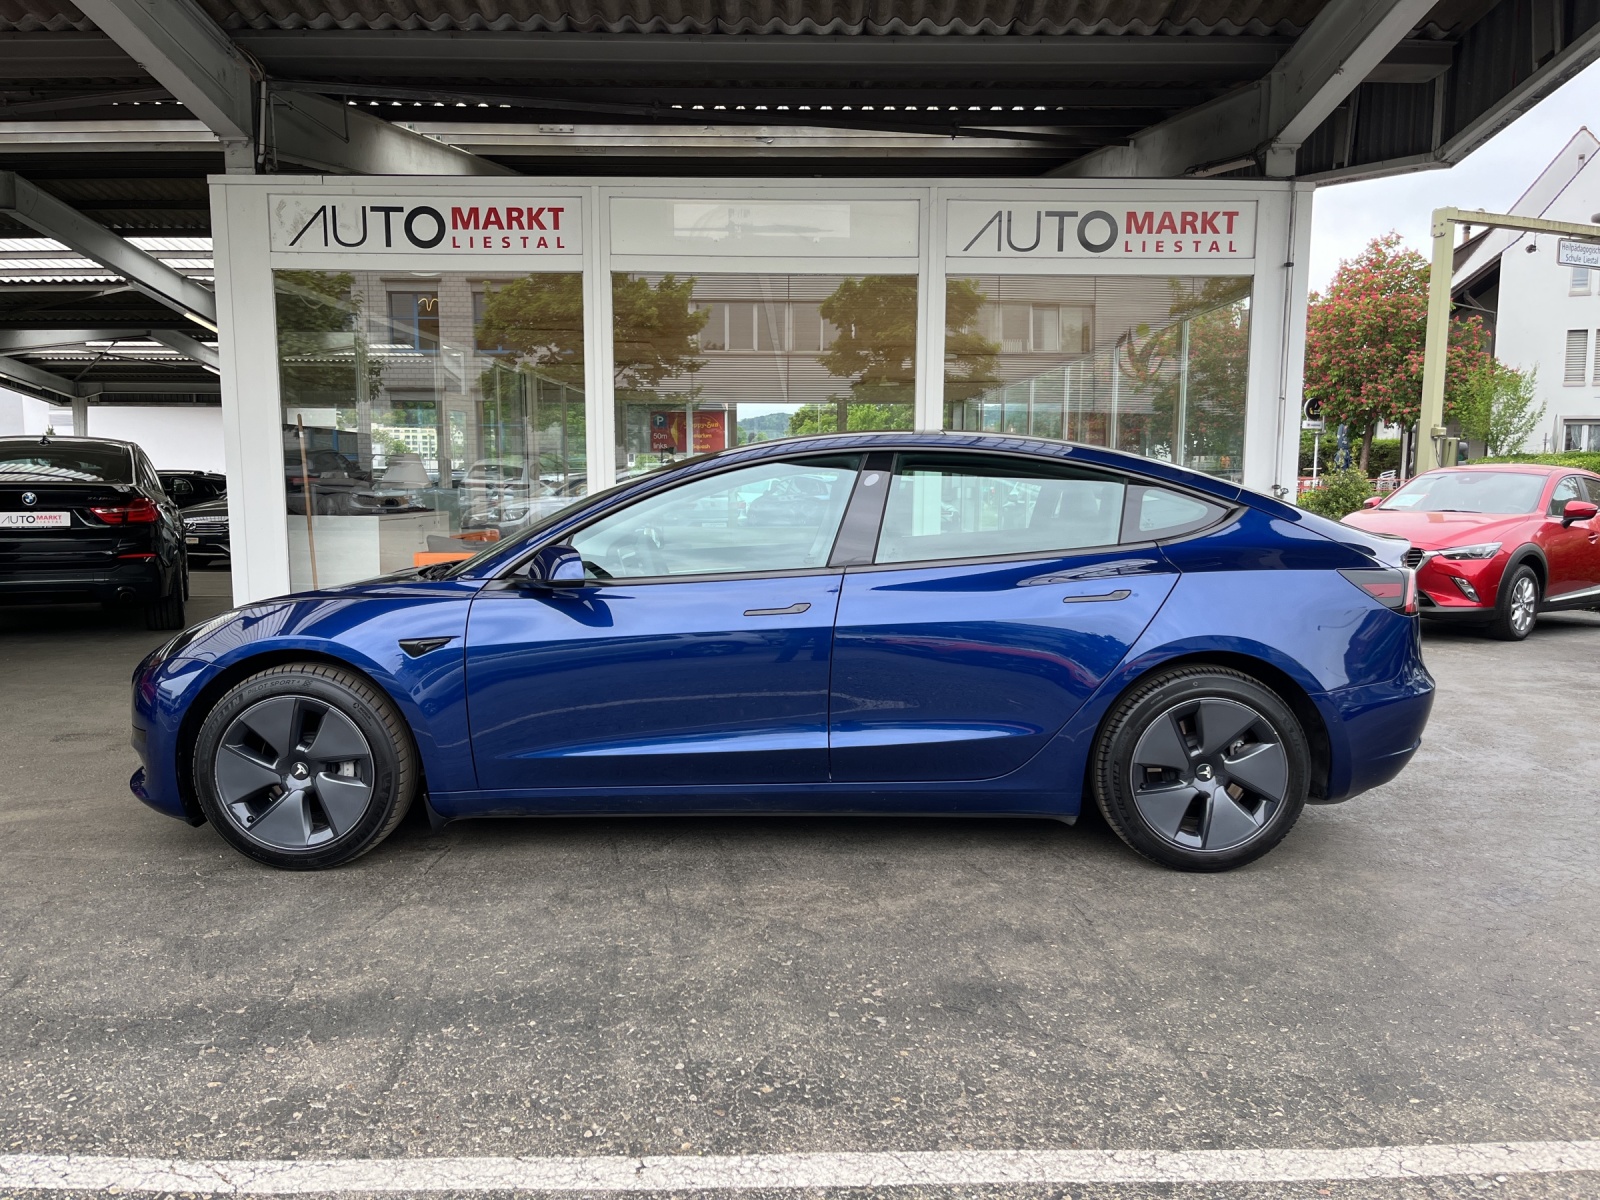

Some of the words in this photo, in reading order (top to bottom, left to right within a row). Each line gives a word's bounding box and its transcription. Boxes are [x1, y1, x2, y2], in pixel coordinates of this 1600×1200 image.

[288, 204, 446, 249] AUTO
[451, 206, 565, 231] MARKT
[962, 209, 1119, 253] AUTO
[1125, 211, 1239, 235] MARKT
[451, 236, 565, 249] LIESTAL
[1124, 240, 1238, 253] LIESTAL
[1566, 254, 1581, 262] Schule
[1583, 256, 1598, 264] Liestal
[656, 416, 664, 426] P
[653, 432, 668, 440] 50m
[1, 515, 36, 524] AUTO
[270, 679, 296, 687] SPORT
